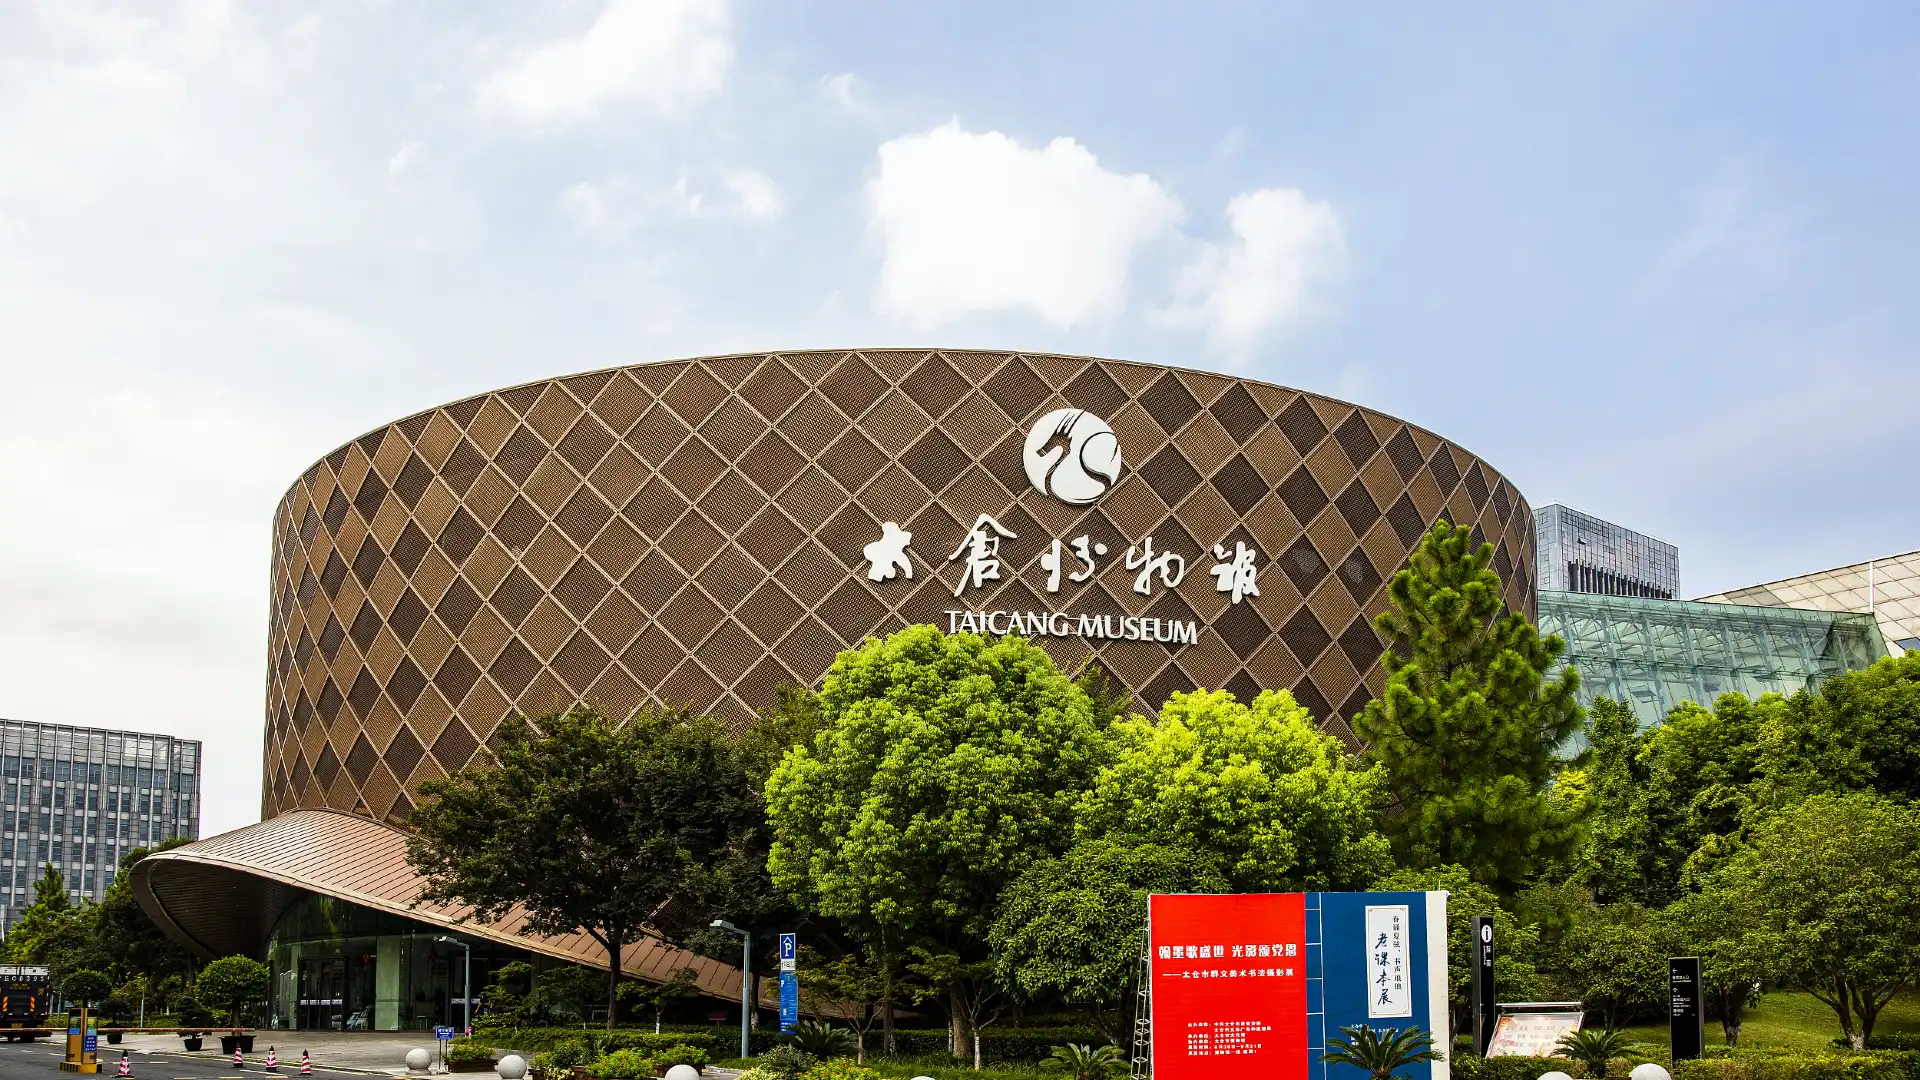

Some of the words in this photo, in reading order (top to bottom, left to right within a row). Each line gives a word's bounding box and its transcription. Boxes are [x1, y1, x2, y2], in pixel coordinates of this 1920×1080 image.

[944, 610, 1069, 637] TAICANG
[1077, 613, 1198, 645] MUSEUM
[784, 942, 792, 957] P
[1158, 945, 1225, 959] 翰墨歌盛世
[1231, 943, 1298, 958] 光影颂党恩
[1374, 931, 1393, 1005] 老课本展
